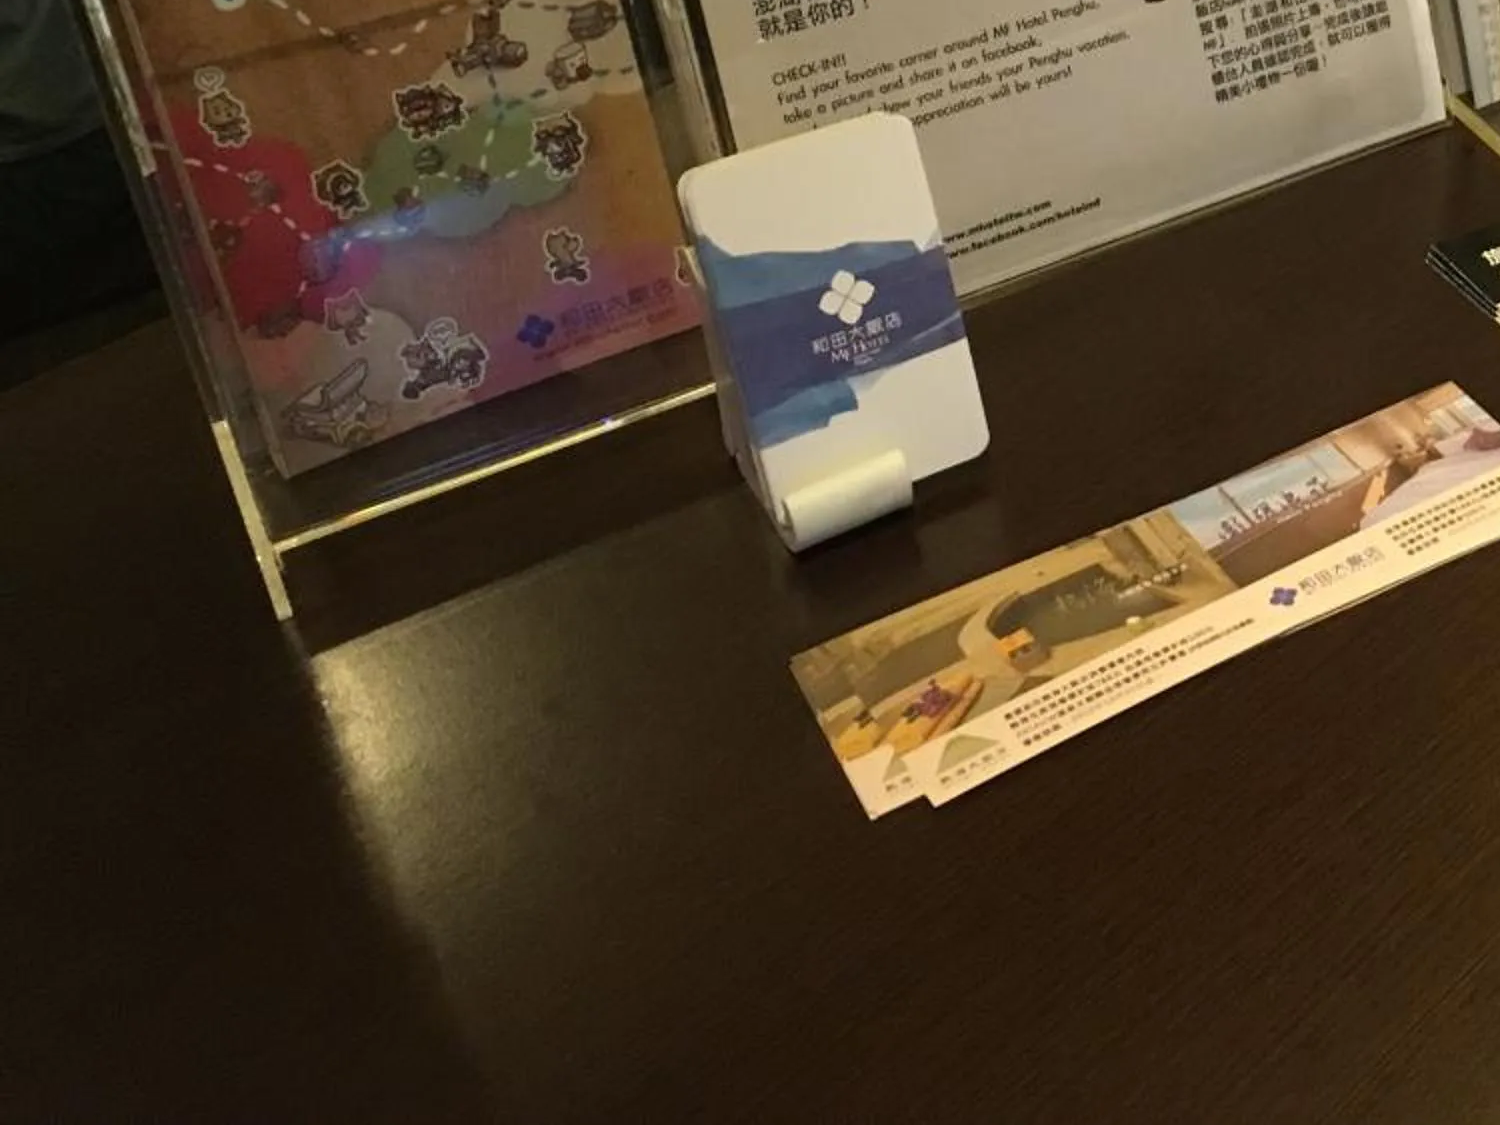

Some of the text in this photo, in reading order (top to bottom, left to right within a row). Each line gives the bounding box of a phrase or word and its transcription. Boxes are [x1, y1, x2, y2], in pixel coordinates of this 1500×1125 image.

[811, 78, 840, 102] your
[845, 62, 895, 87] favorite
[899, 49, 938, 72] corner
[943, 31, 989, 55] around
[1016, 11, 1049, 34] Hotel
[917, 86, 945, 108] your
[949, 71, 992, 95] friends
[998, 58, 1025, 83] your
[1027, 45, 1074, 74] Penghu
[989, 79, 1012, 101] will
[1014, 77, 1032, 94] be
[1036, 63, 1074, 89] yours!
[783, 106, 813, 126] take
[816, 104, 828, 116] a
[831, 88, 875, 114] picture
[879, 76, 905, 96] and
[908, 65, 945, 88] share
[947, 57, 957, 74] it
[961, 55, 979, 71] on
